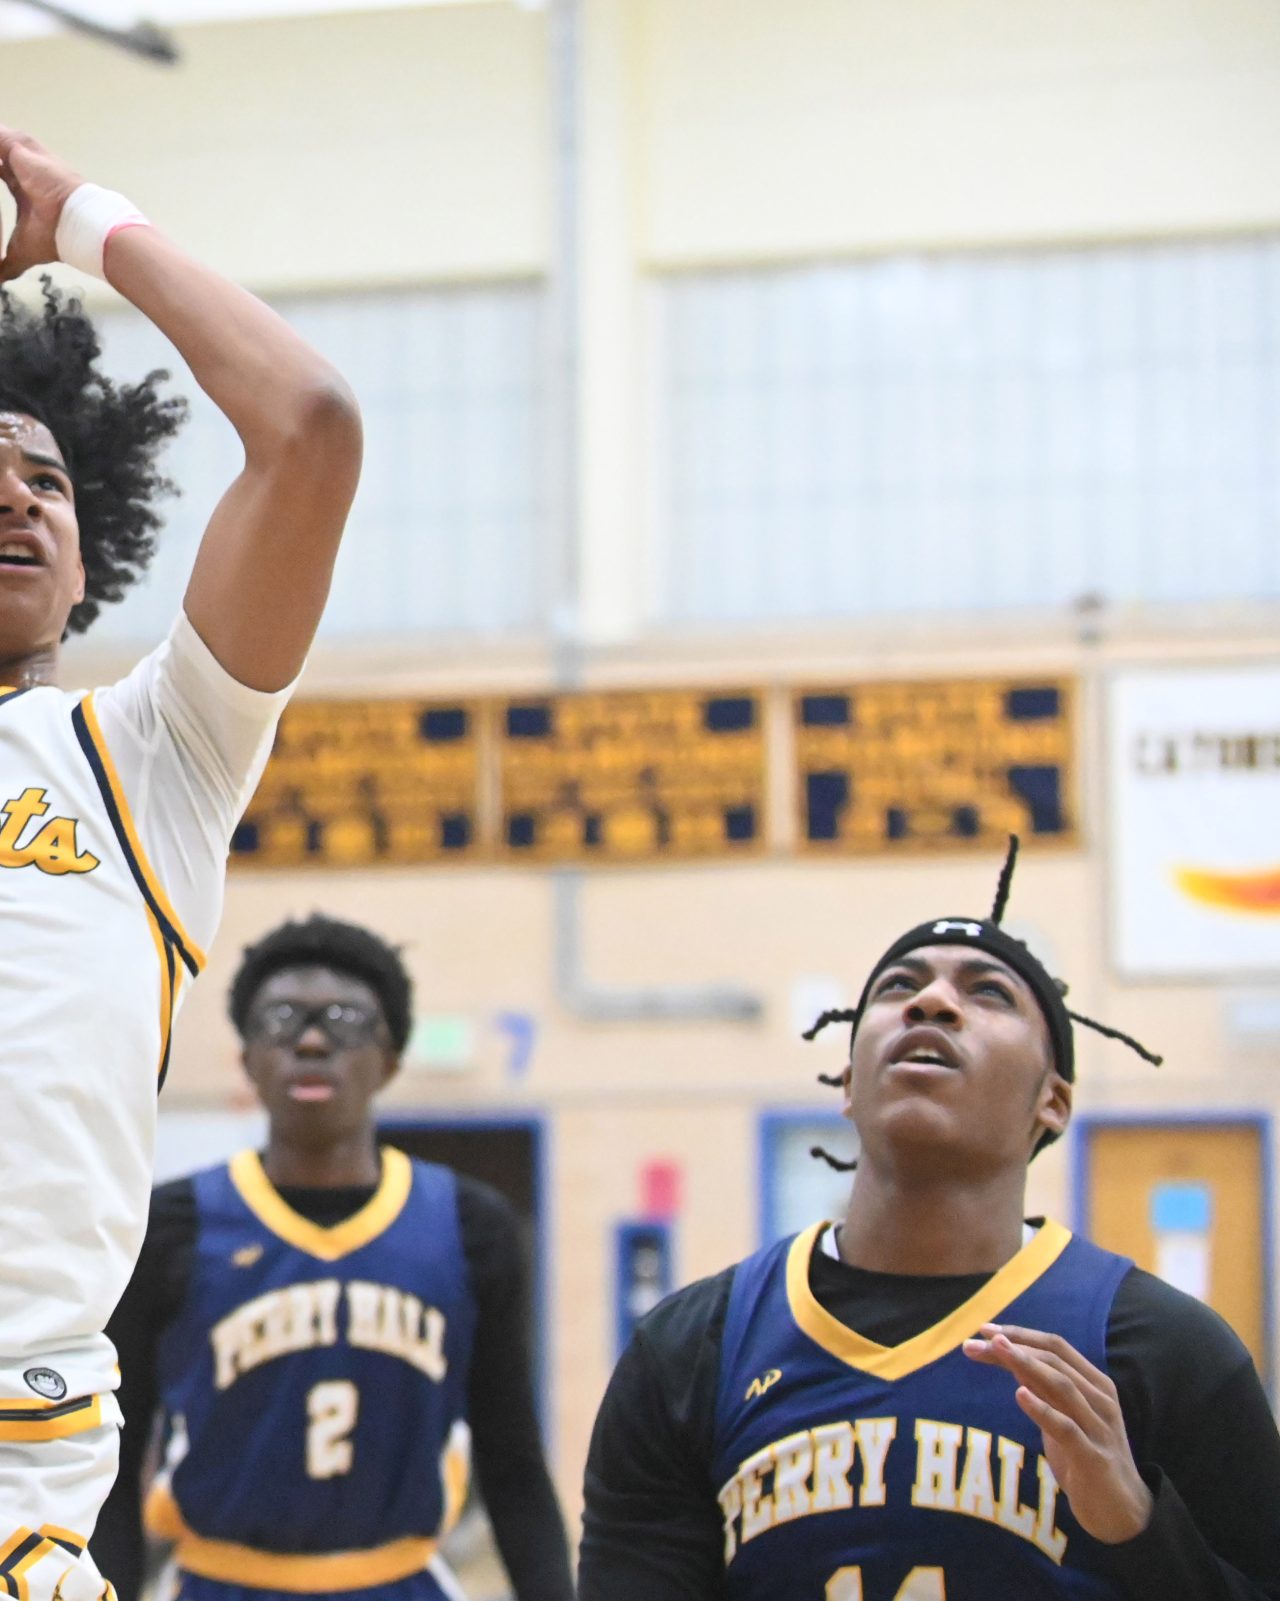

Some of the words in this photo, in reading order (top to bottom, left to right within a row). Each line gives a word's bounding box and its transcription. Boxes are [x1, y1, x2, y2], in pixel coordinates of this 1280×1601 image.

[211, 1279, 342, 1390] PERRY
[345, 1279, 449, 1384] HALL
[305, 1378, 359, 1481] 2
[718, 1417, 897, 1568] PERRY
[911, 1417, 1068, 1567] HALL
